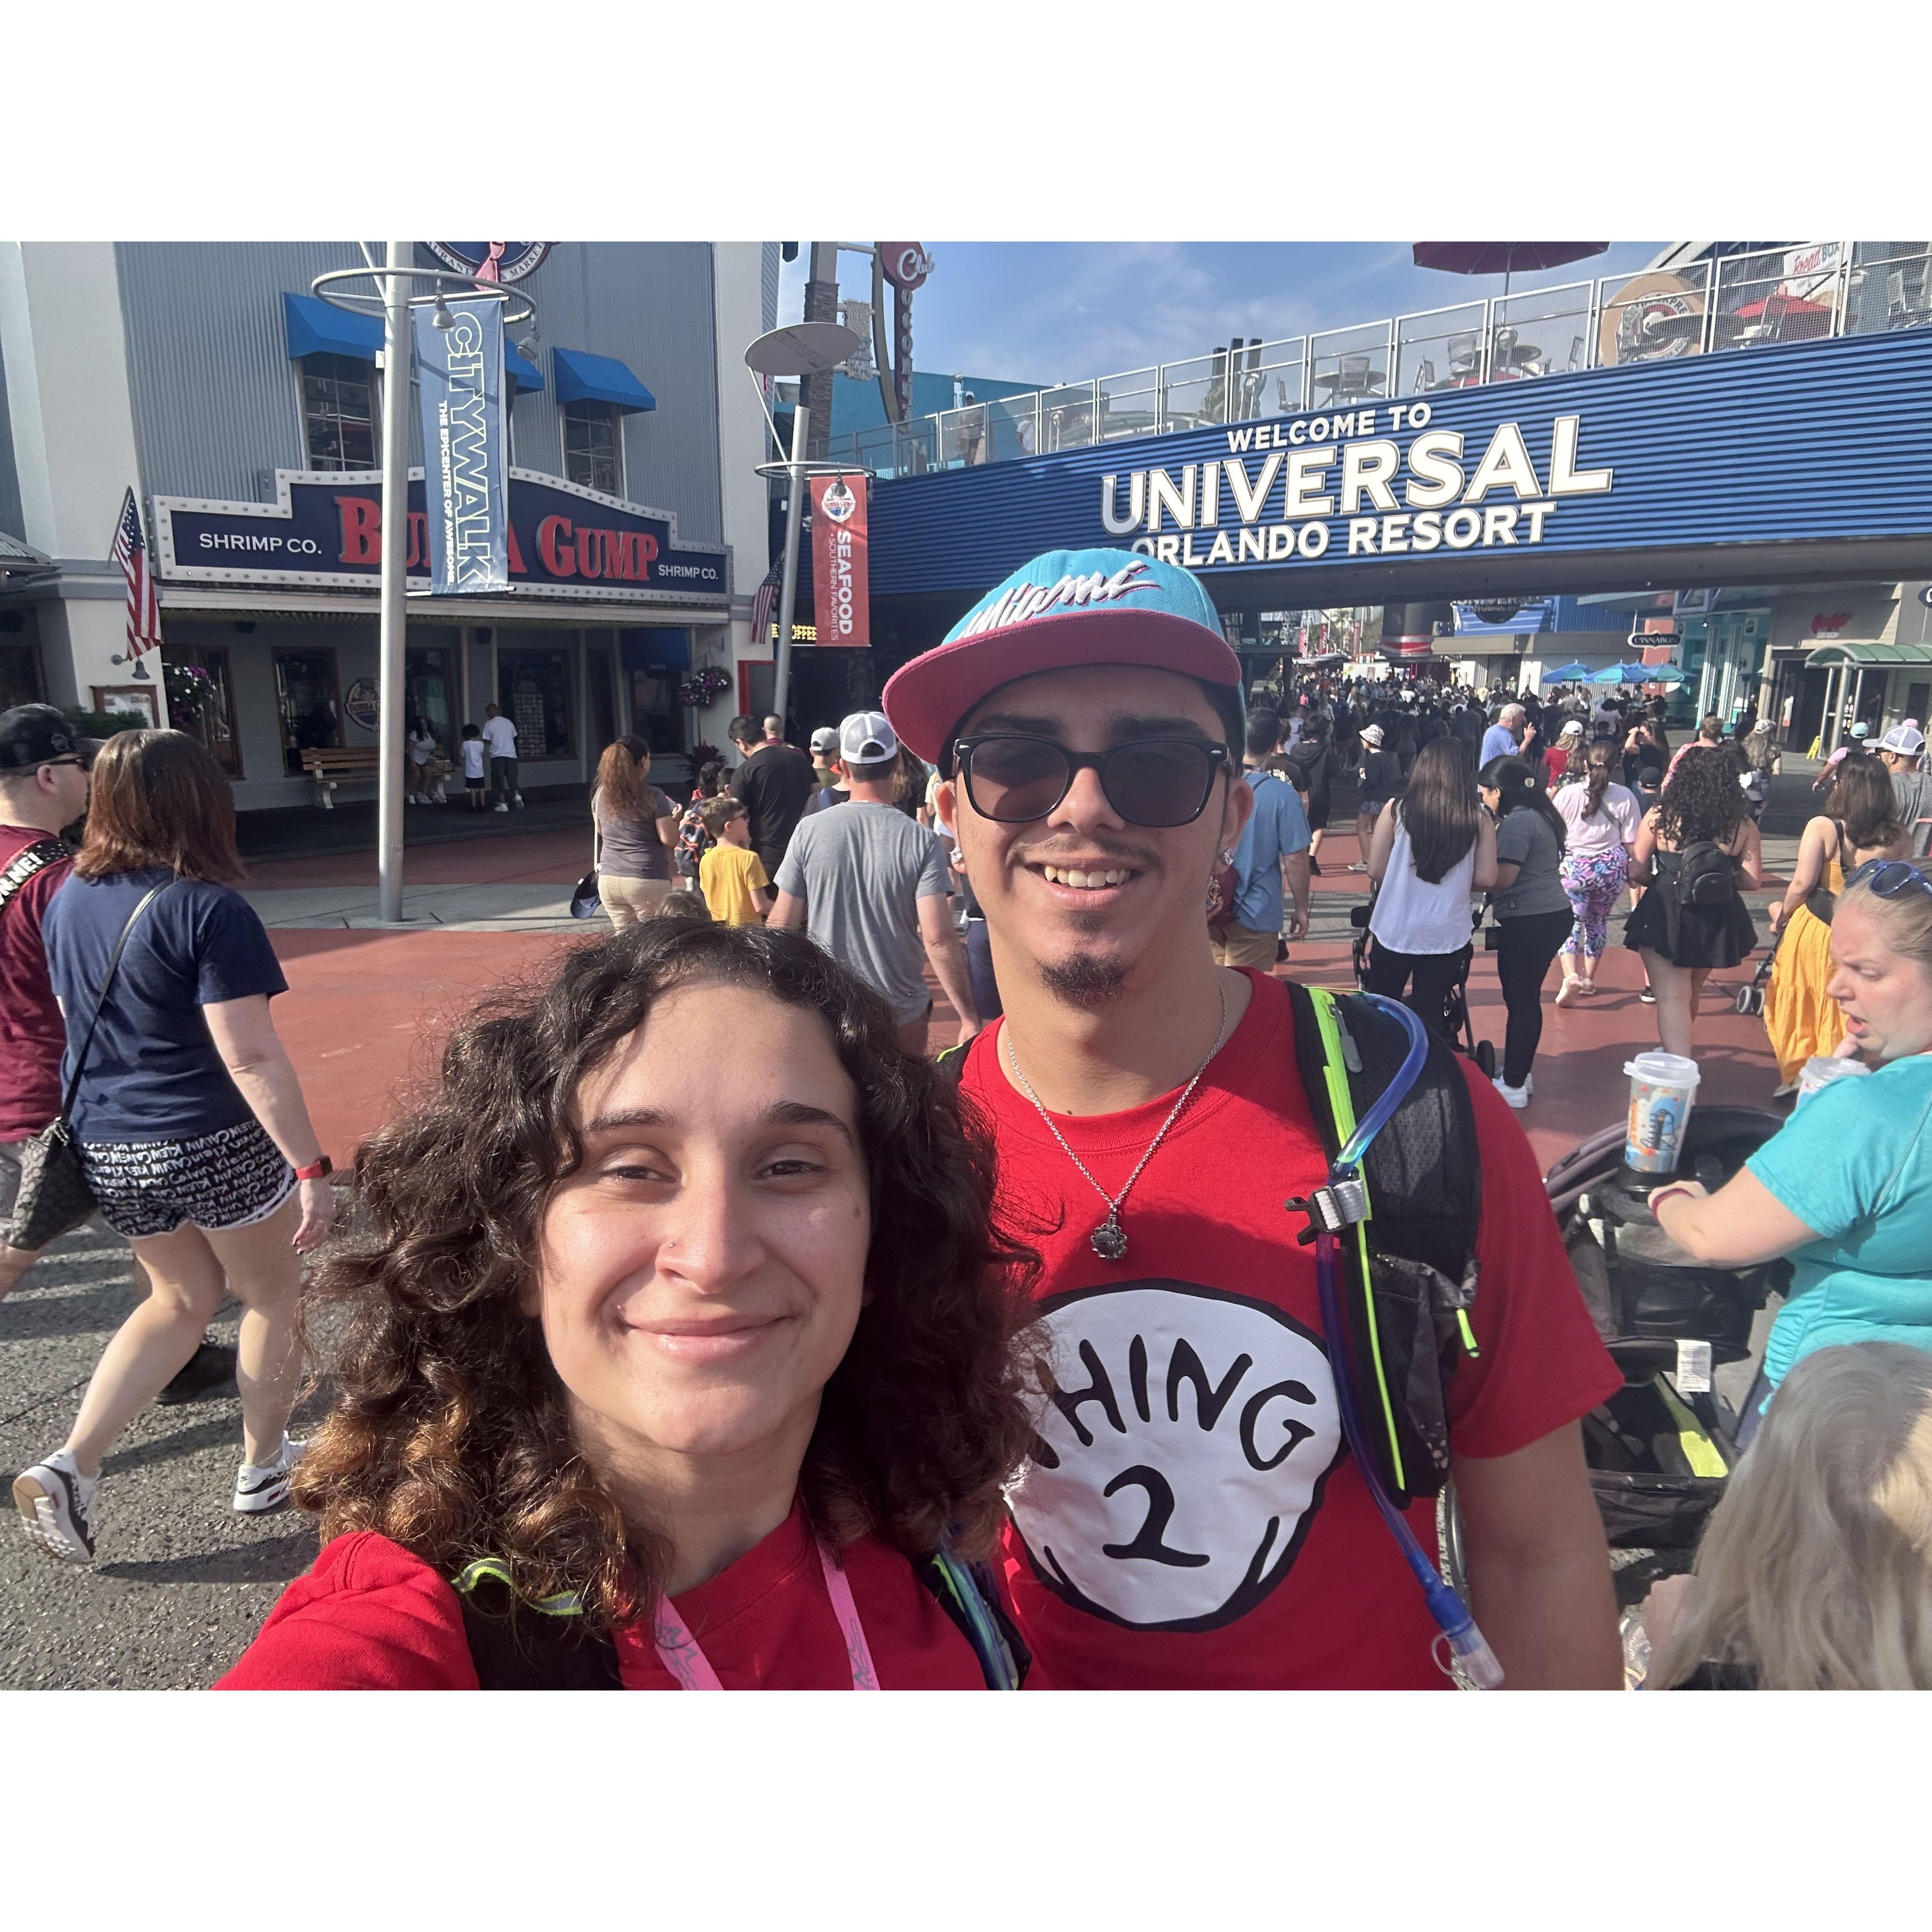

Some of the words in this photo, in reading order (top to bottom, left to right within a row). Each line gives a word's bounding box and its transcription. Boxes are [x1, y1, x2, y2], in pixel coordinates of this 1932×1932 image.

[511, 242, 543, 276] MARKET
[897, 248, 935, 282] Club
[438, 400, 448, 426] THE
[1226, 409, 1376, 453] WELCOME
[1388, 402, 1432, 431] TO
[440, 428, 452, 498] EPICENTER
[445, 312, 490, 584] CITYWALK
[1100, 414, 1613, 536] UNIVERSAL
[444, 499, 453, 518] OF
[1132, 520, 1330, 567] ORLANDO
[1347, 501, 1557, 556] RESORT
[199, 533, 282, 552] SHRIMP
[287, 539, 322, 554] CO.
[536, 515, 658, 581] GUMP
[829, 538, 838, 589] SOUTHERN
[658, 564, 700, 579] SHRIMP
[701, 568, 719, 580] CO.
[837, 530, 853, 635] SEAFOOD
[830, 592, 839, 641] FAVORITES
[957, 560, 1164, 641] Miami
[8, 851, 43, 883] ME!
[1103, 1464, 1210, 1567] 2
